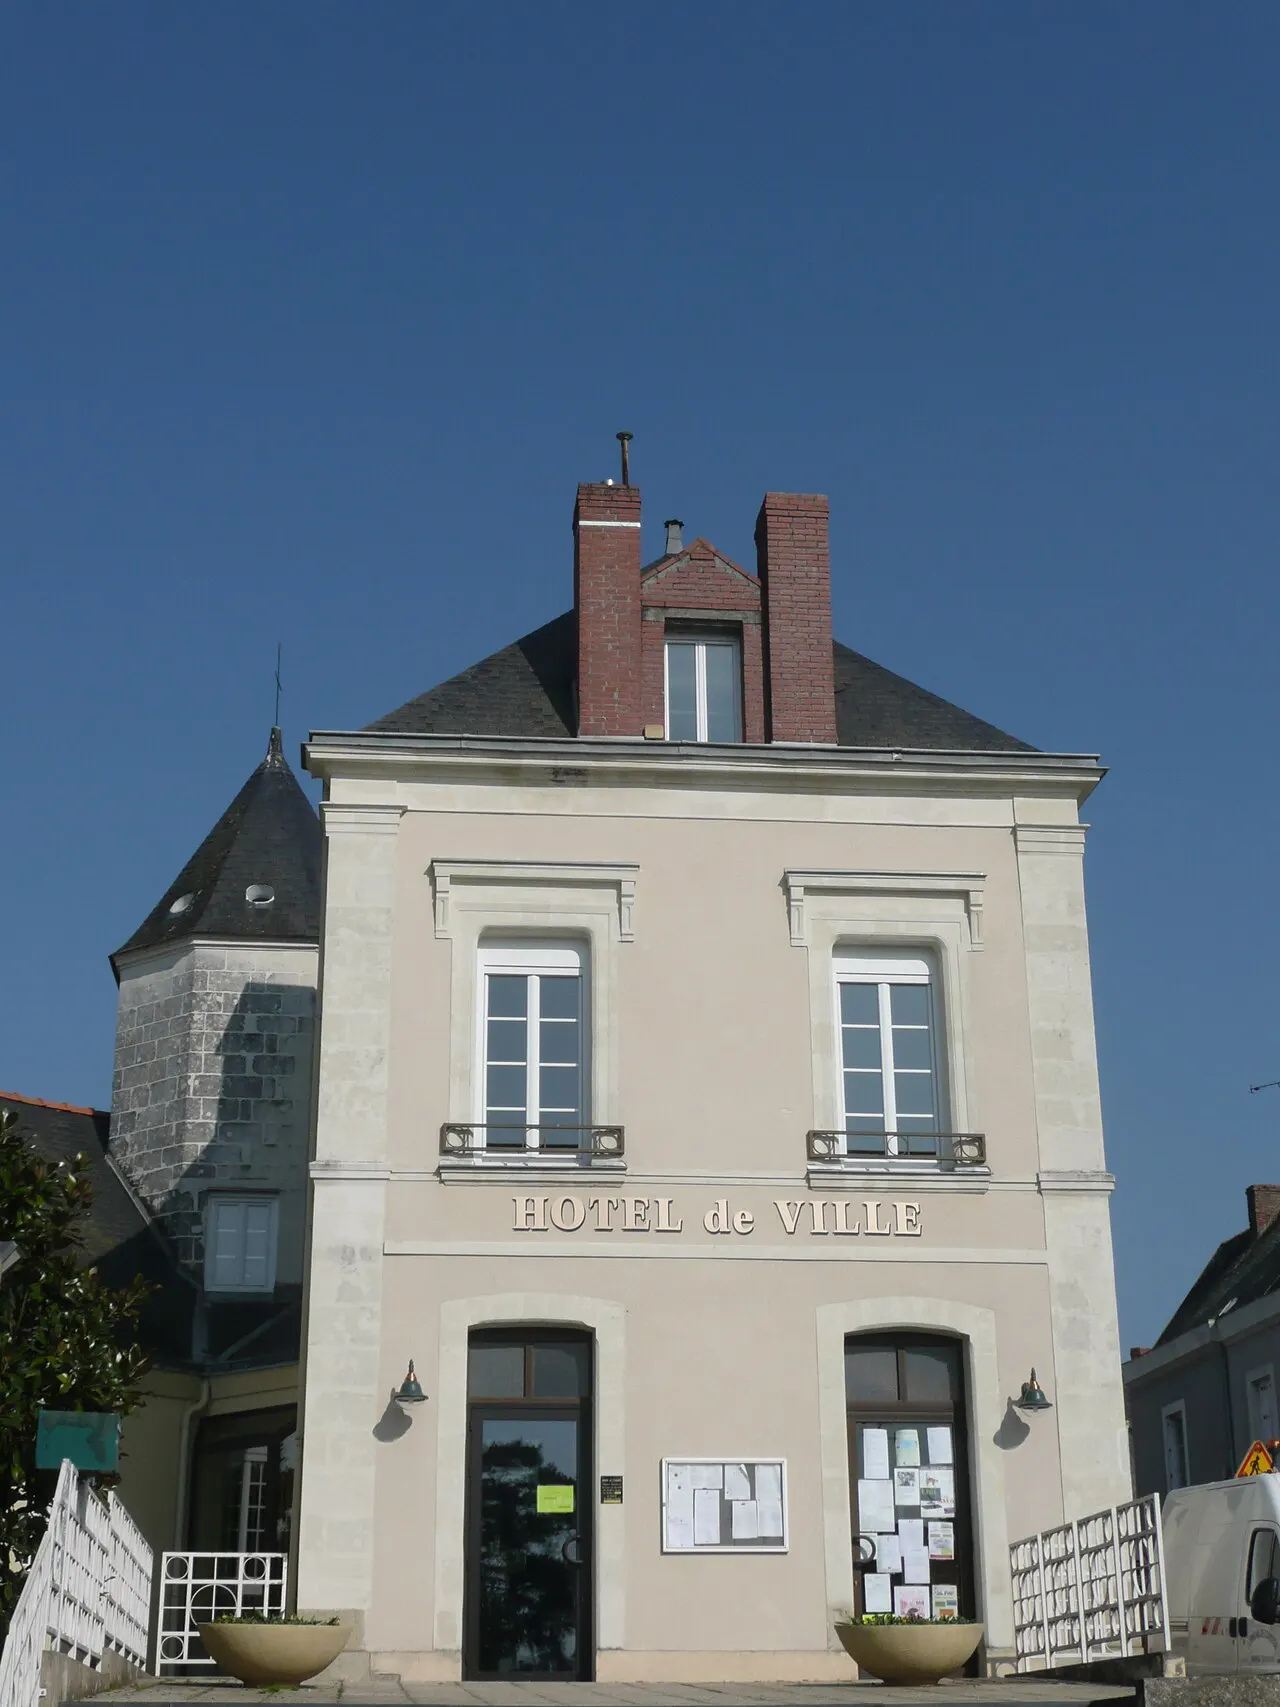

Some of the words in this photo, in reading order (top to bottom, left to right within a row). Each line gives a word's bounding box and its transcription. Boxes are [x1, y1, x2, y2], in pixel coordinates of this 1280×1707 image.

[512, 1196, 683, 1232] HOTEL
[703, 1199, 755, 1235] de
[773, 1201, 923, 1237] VILLE
